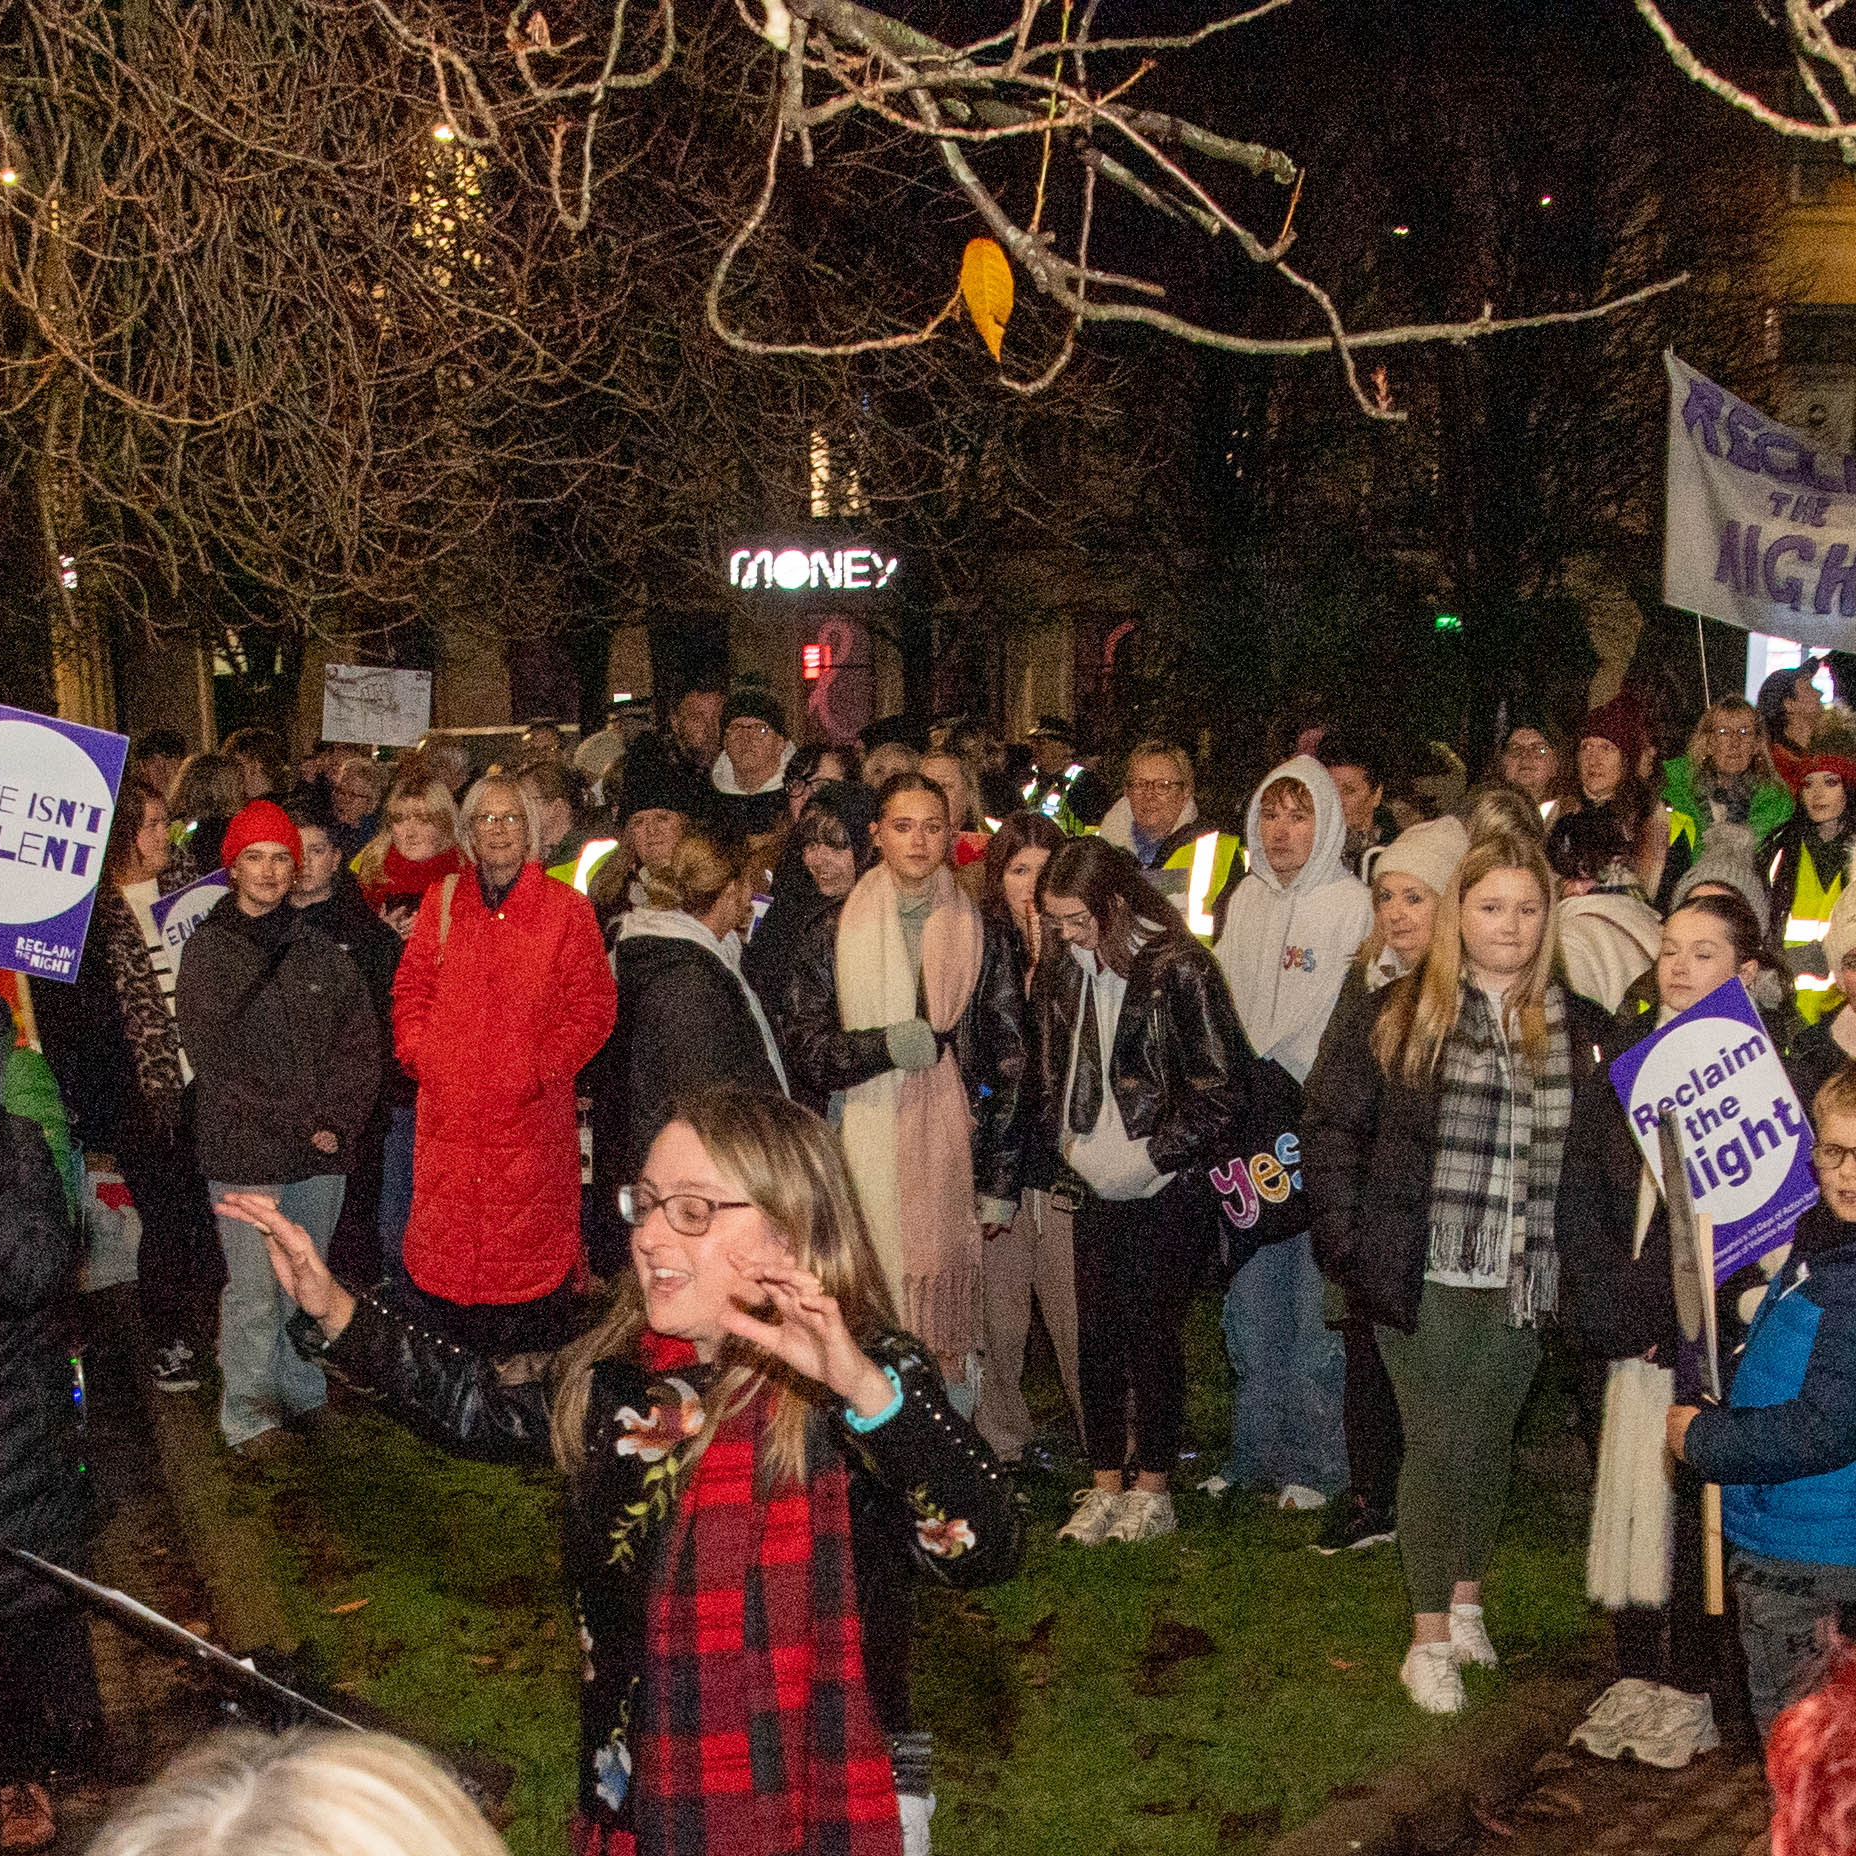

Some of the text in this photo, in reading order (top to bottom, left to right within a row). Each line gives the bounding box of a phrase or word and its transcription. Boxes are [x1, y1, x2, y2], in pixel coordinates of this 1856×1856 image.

[1768, 492, 1831, 527] THE
[730, 549, 898, 590] MONEY
[27, 792, 107, 834] ISN'T
[15, 936, 76, 960] RECLAIM
[30, 954, 72, 974] NIGHT
[1684, 1095, 1741, 1142] the
[1685, 1096, 1802, 1200] ight
